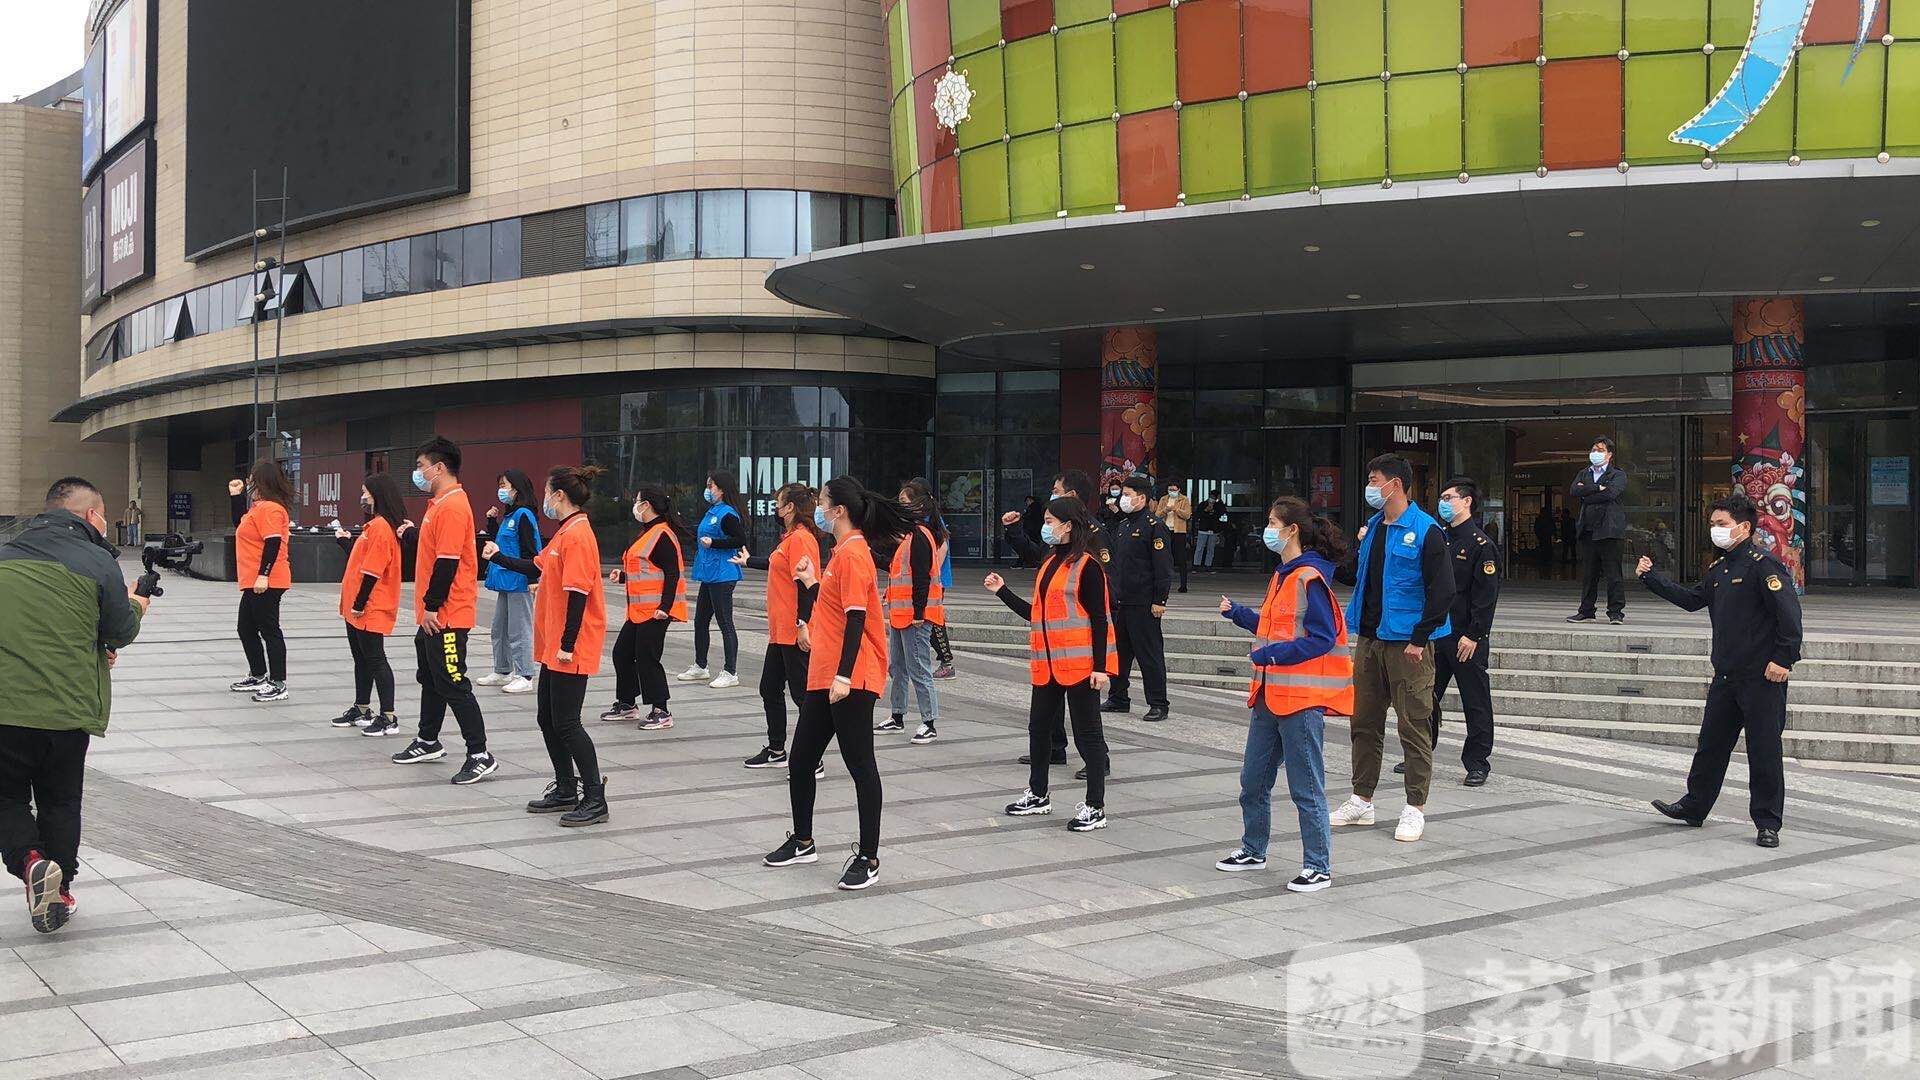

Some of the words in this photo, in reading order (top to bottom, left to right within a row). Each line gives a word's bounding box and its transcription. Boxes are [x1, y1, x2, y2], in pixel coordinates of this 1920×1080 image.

[111, 172, 138, 237] MUJI
[1393, 425, 1419, 444] MUJI
[318, 473, 341, 502] MUJI
[739, 457, 832, 494] MUJI
[443, 632, 462, 683] BREAK
